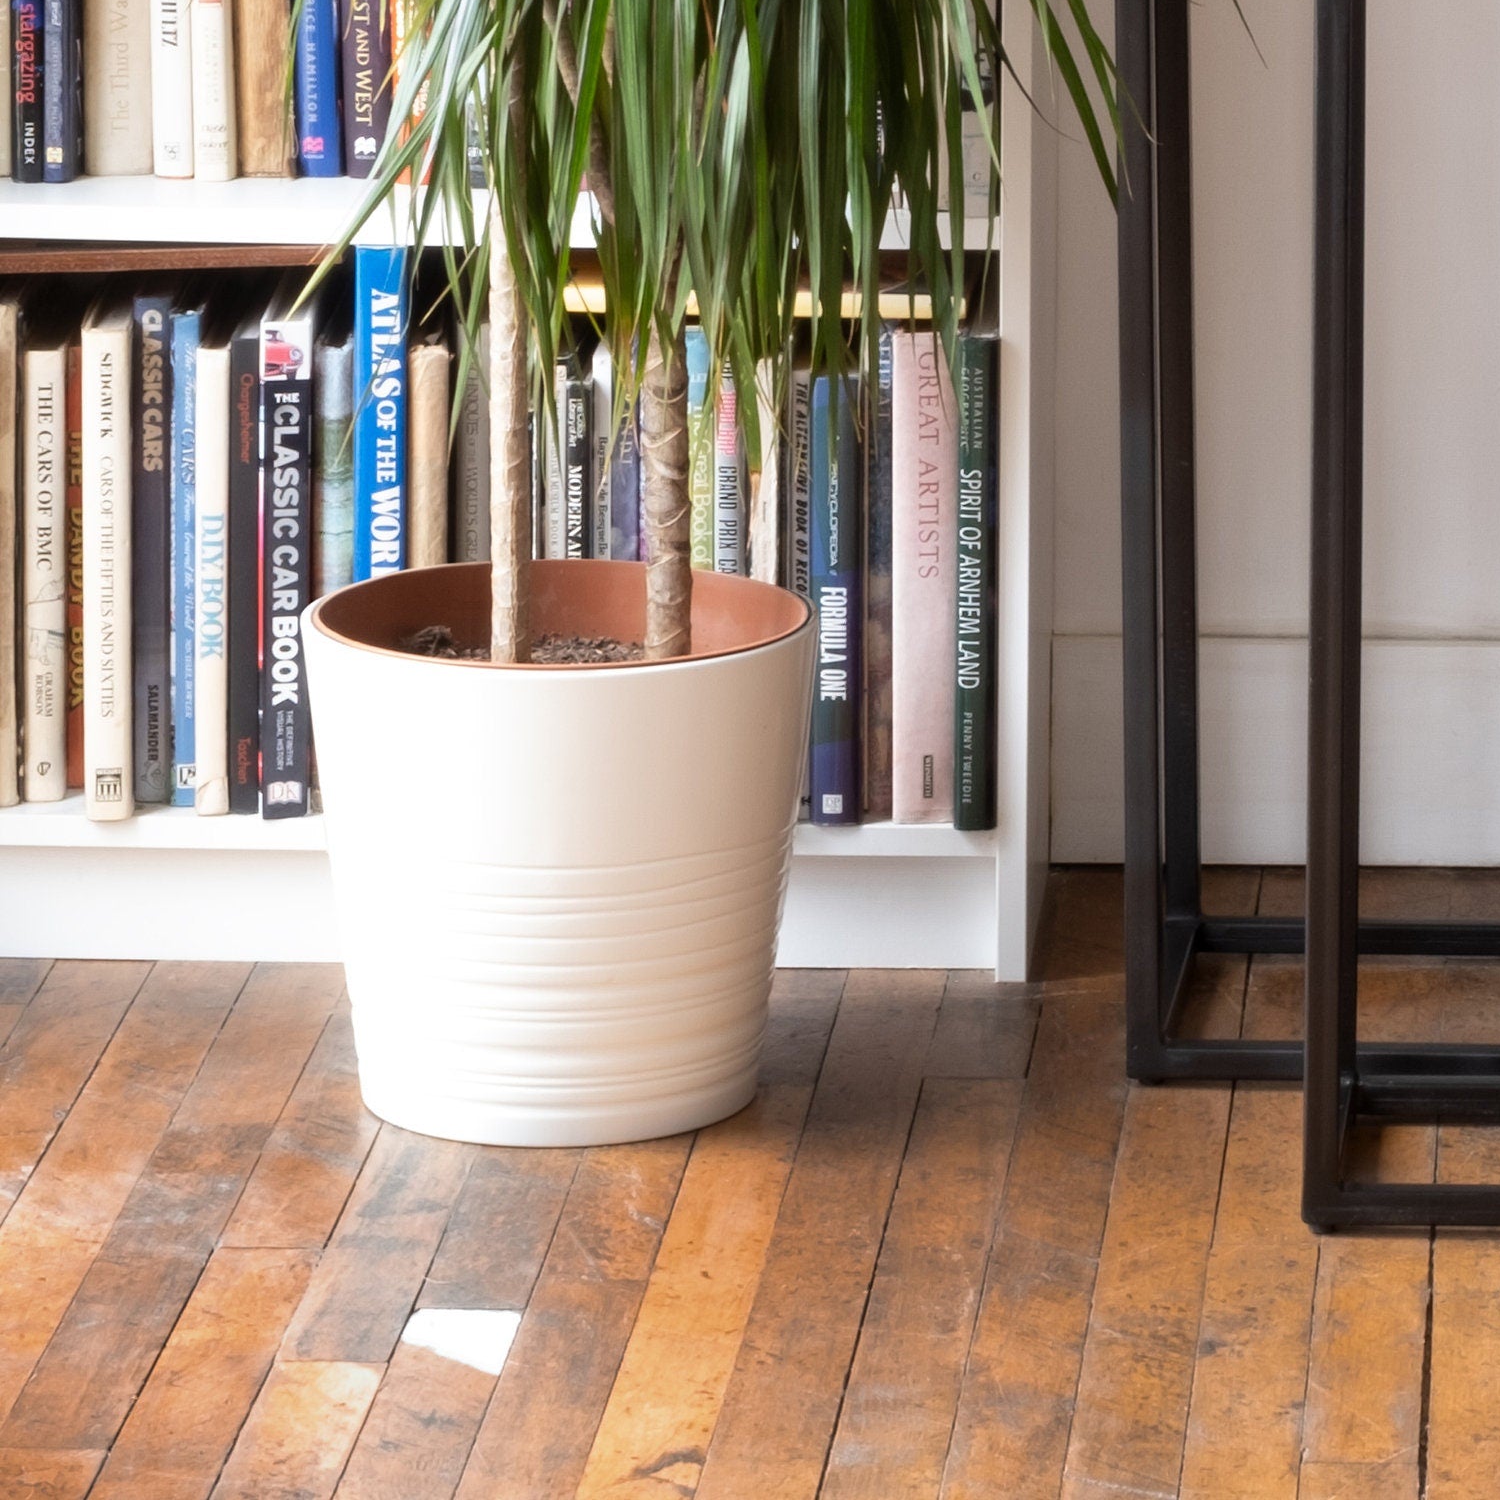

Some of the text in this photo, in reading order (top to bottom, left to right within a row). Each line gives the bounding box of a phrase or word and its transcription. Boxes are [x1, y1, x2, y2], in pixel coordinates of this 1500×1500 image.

[15, 3, 37, 104] stargazing
[108, 41, 130, 95] Third
[305, 41, 319, 123] HAMILTON
[354, 29, 370, 66] AND
[354, 68, 375, 126] WEST
[23, 122, 36, 165] INDEX
[141, 309, 164, 472] CLASSIC CARS
[237, 372, 256, 466] Chargesheimer
[273, 391, 301, 404] THE
[972, 367, 984, 450] AUSTRALIAN
[36, 382, 54, 571] THE CARS OF BMC
[181, 427, 197, 486] CARS
[370, 288, 403, 581] ATLAS OF THE WORL
[795, 382, 808, 556] THE BOOK OF
[917, 351, 941, 580] GREAT ARTISTS
[100, 352, 114, 719] SEDGWICK CARS OF THE FIFTIES AND SIXTIES
[567, 464, 584, 537] MODERN
[693, 494, 713, 544] Book
[718, 465, 738, 550] GRAND PRIX
[271, 404, 301, 707] CLASSIC CAR BOOK
[693, 545, 713, 564] of
[957, 468, 983, 690] SPIRIT OF ARNHEM LAND
[199, 576, 225, 661] BOOK
[820, 586, 848, 702] FORMULA ONE
[44, 672, 54, 718] GRAHAM
[147, 684, 160, 761] SALAMANDER
[238, 736, 252, 786] Taschen
[961, 711, 974, 805] PENNY TWEEDIE
